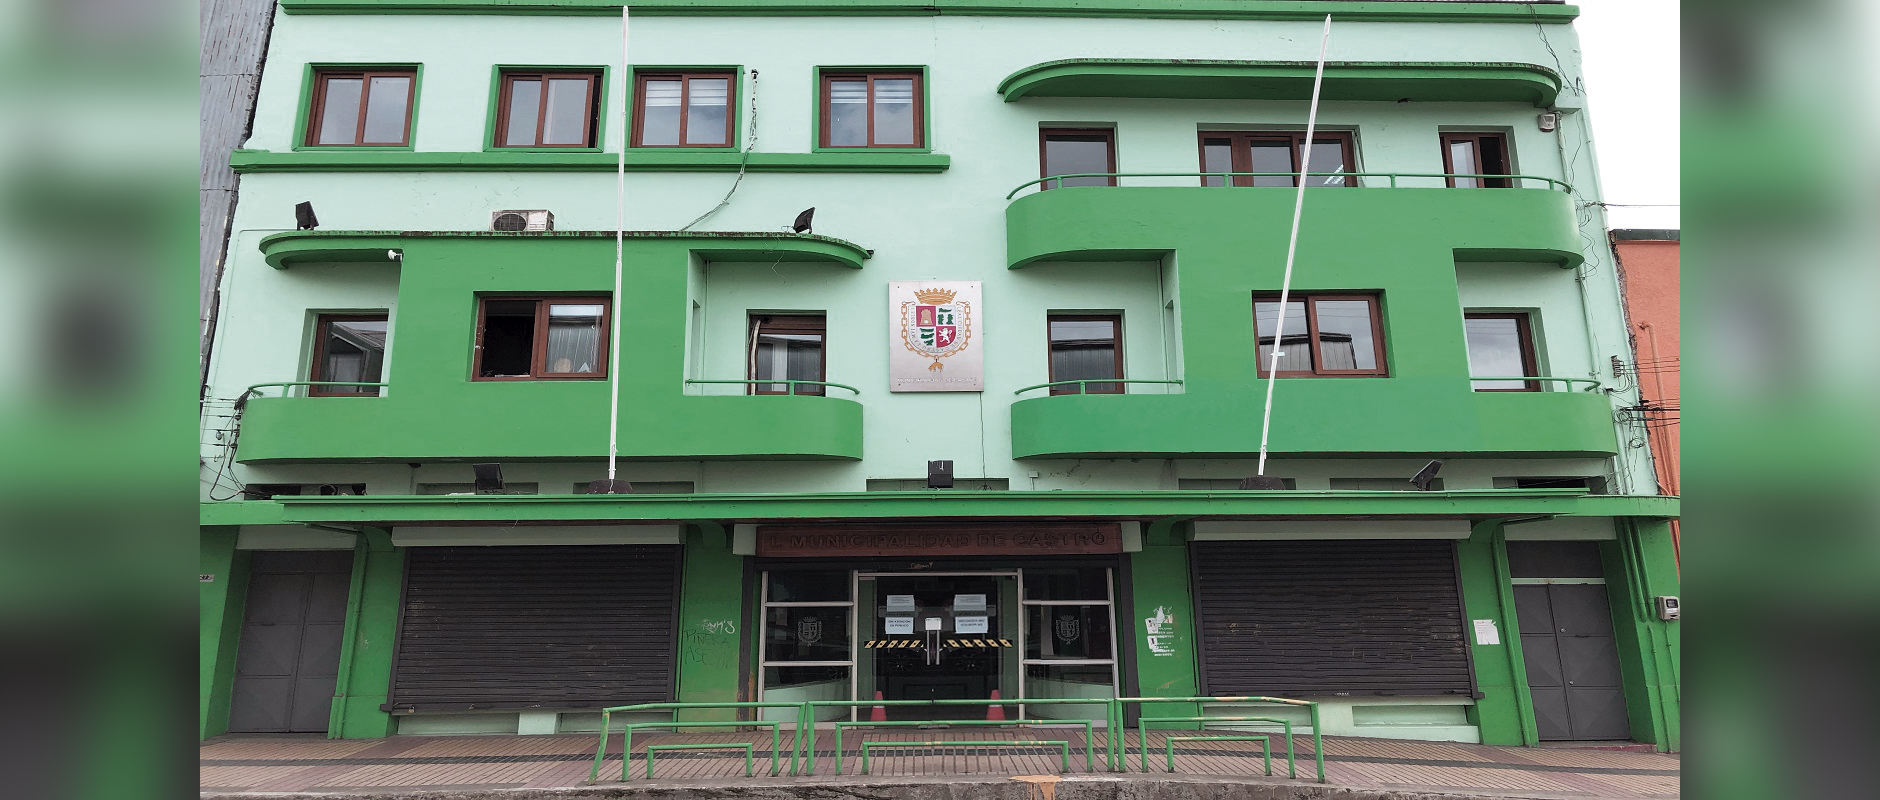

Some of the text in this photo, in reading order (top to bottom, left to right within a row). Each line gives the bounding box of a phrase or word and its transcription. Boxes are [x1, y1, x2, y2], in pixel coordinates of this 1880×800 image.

[790, 534, 972, 549] MUNICIPALIDAD
[977, 533, 1007, 547] DE
[1012, 532, 1107, 547] CASTRO
